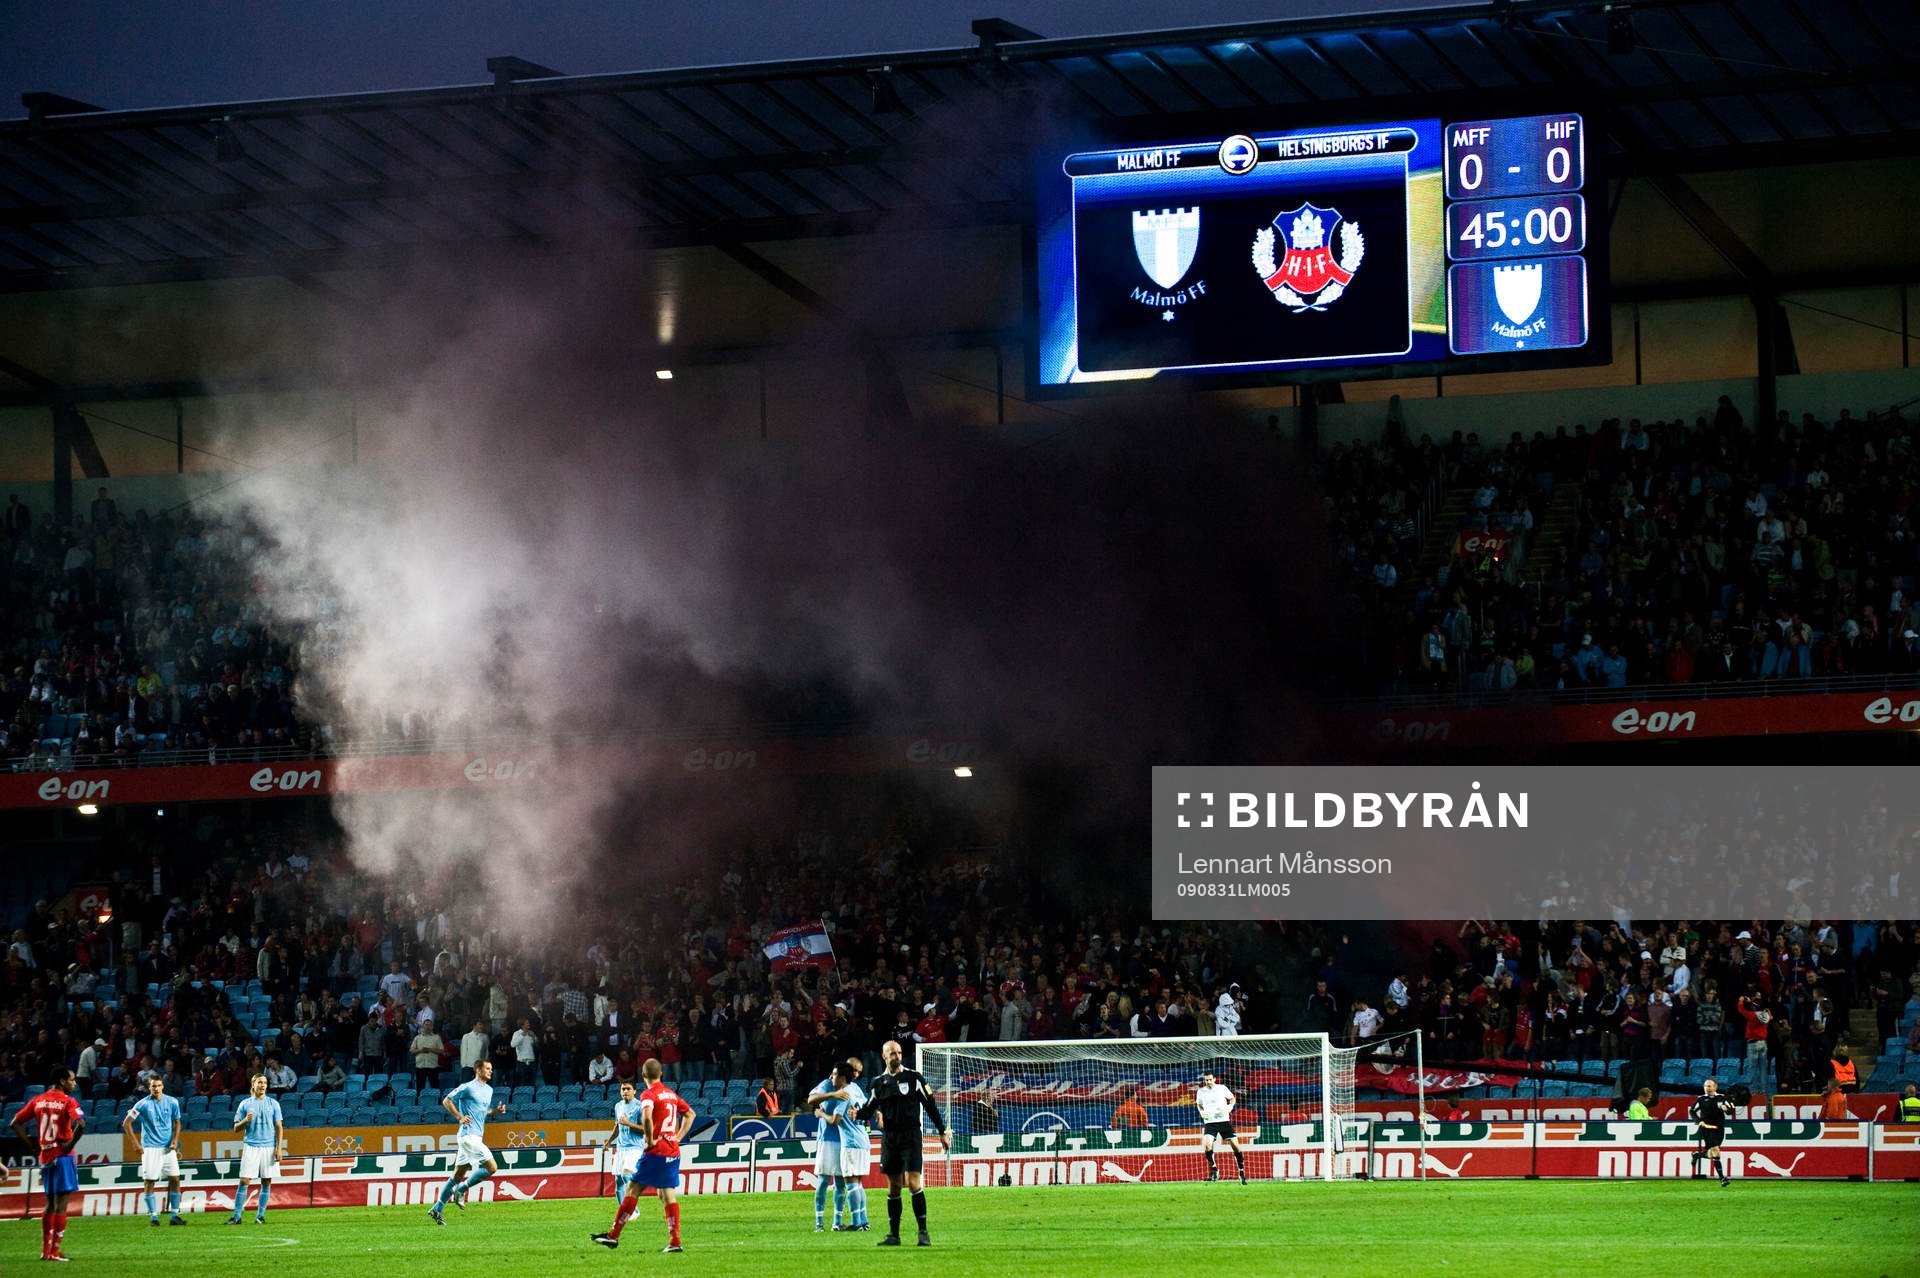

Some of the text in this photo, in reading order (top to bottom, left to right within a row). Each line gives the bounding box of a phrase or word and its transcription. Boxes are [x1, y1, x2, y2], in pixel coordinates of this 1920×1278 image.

[1278, 133, 1391, 157] HELSINGBORGS IF
[1453, 120, 1577, 147] MFF HIF
[1117, 150, 1182, 170] MALMÖ FF
[1459, 154, 1483, 190] 0
[1546, 147, 1571, 183] 0
[1459, 206, 1572, 249] 45:00
[1130, 280, 1208, 306] Malmö FF
[1491, 317, 1547, 338] Malmö FF
[661, 1103, 677, 1133] 21
